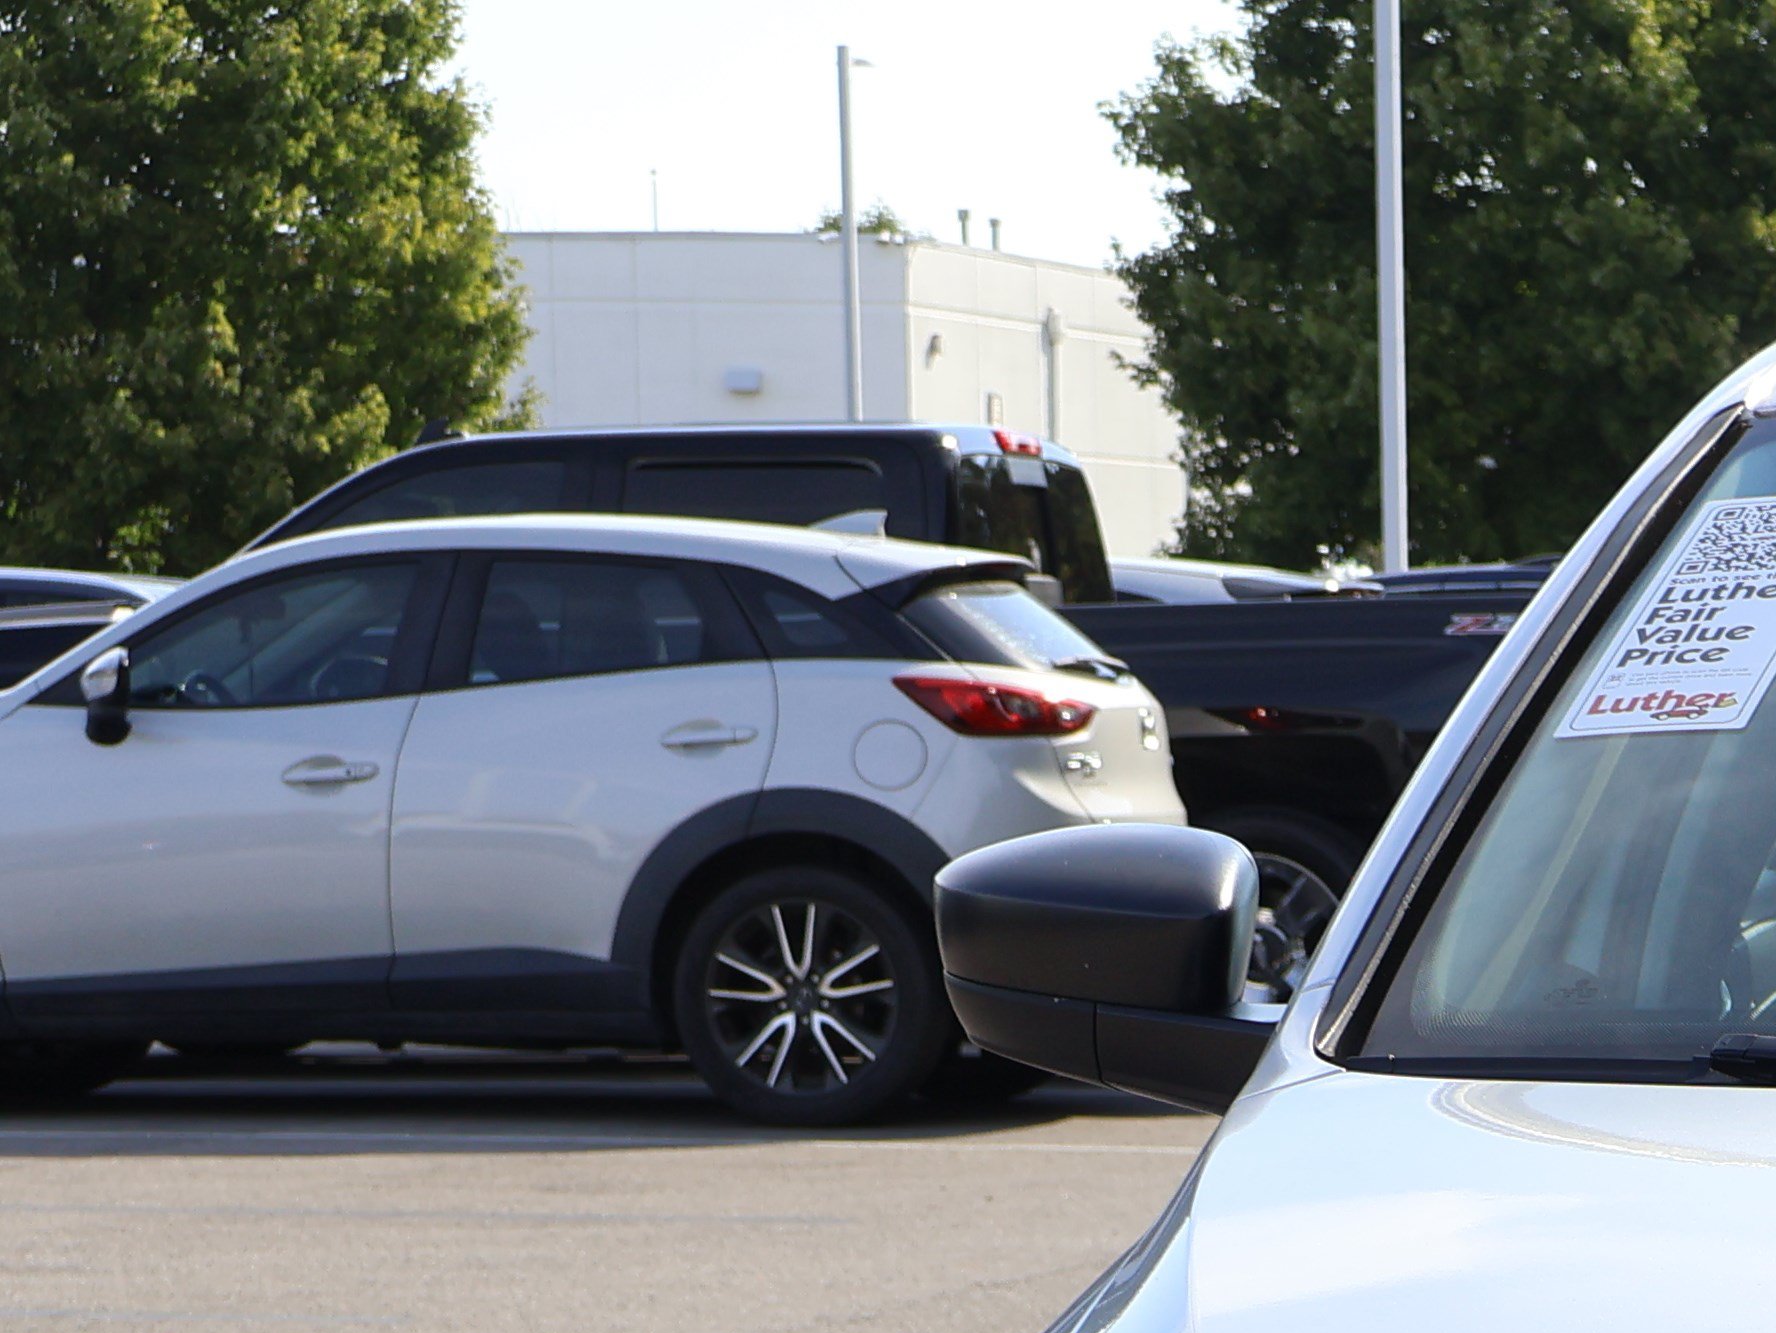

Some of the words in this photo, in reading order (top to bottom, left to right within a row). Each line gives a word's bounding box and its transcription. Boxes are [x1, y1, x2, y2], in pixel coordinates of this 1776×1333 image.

[1711, 575, 1729, 583] to
[1733, 574, 1762, 582] see
[1643, 602, 1727, 626] Fair
[1636, 623, 1756, 646] Value
[1615, 644, 1731, 669] Price
[1586, 689, 1738, 716] Luther
